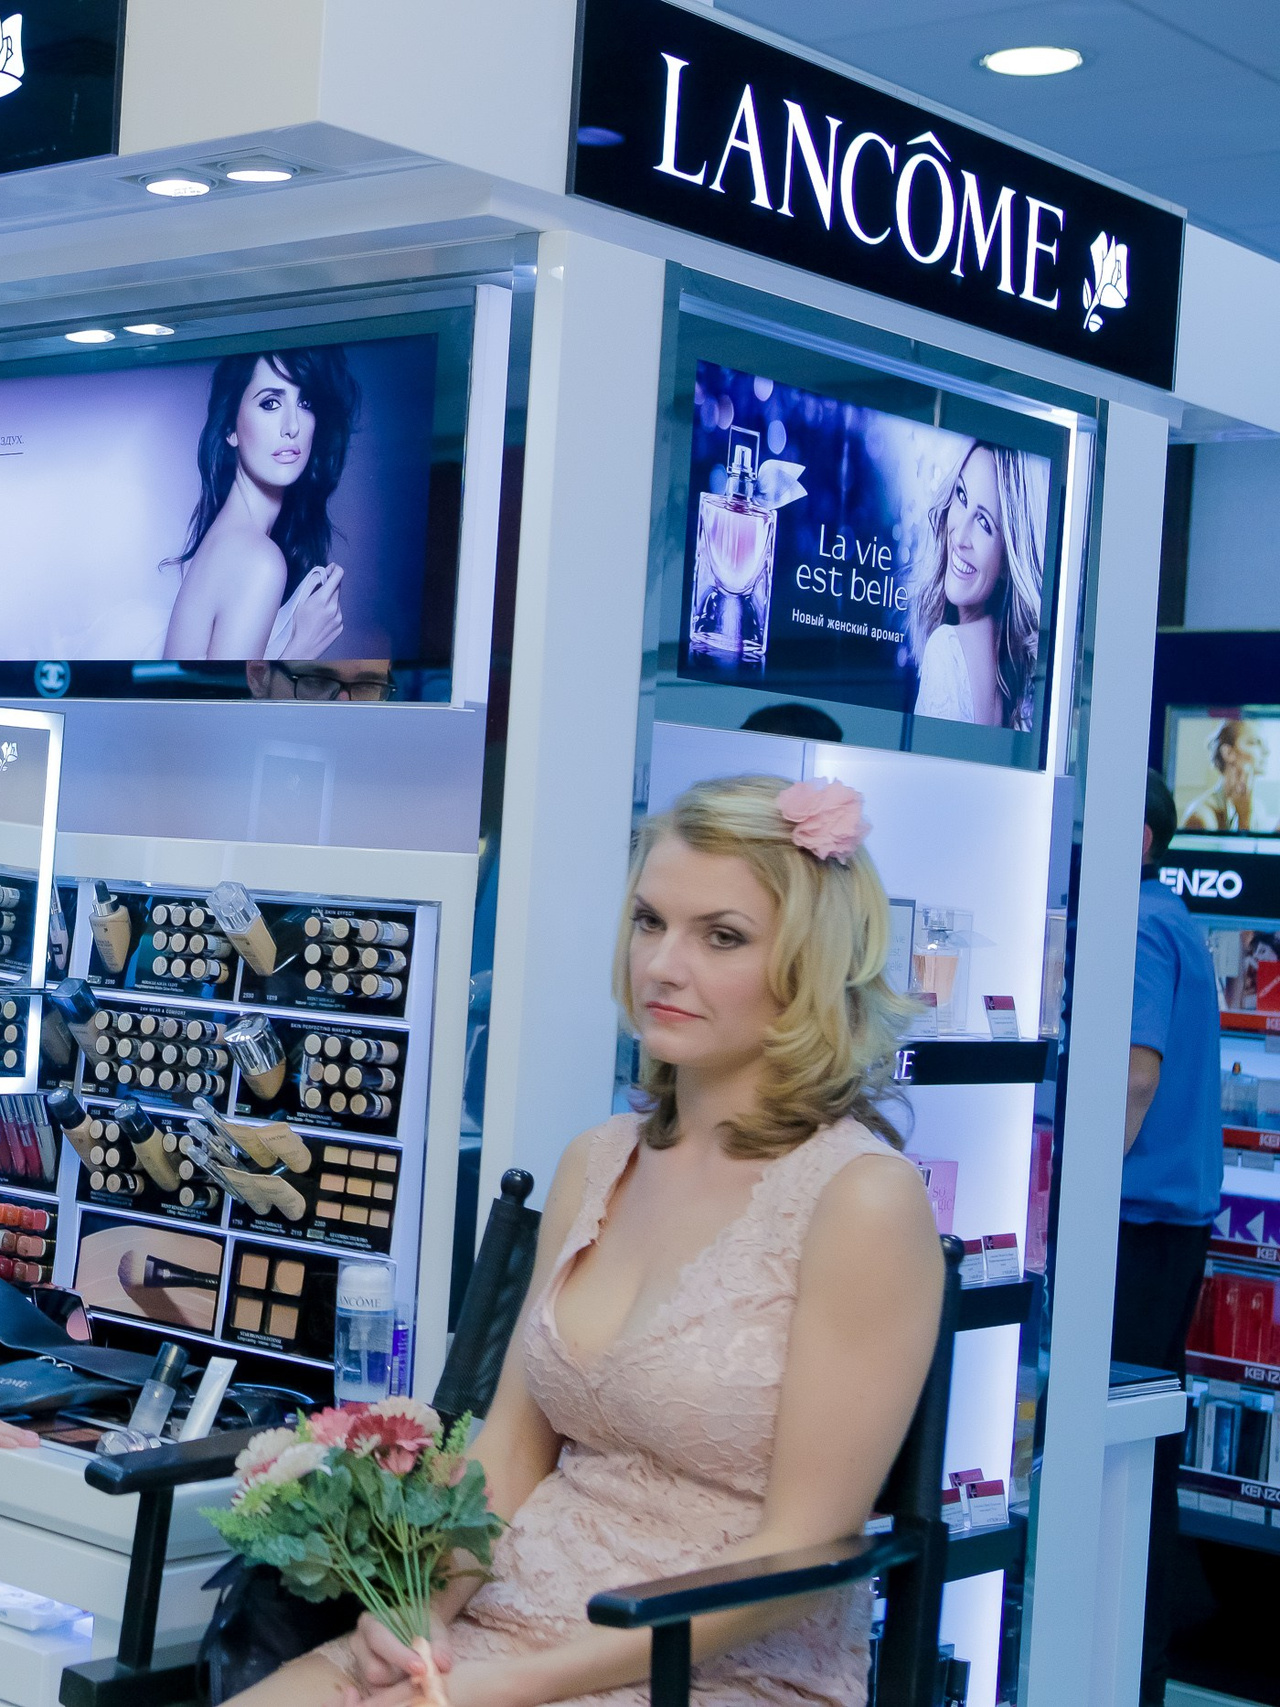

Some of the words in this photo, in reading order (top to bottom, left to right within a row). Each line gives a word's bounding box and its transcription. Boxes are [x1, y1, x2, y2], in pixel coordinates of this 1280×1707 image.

[652, 52, 1066, 310] LANCÔME
[819, 523, 846, 561] La
[856, 536, 892, 571] vie
[796, 564, 843, 597] est
[850, 568, 908, 611] belle
[792, 608, 824, 627] Новый
[827, 618, 868, 636] женский
[871, 627, 905, 643] аромат
